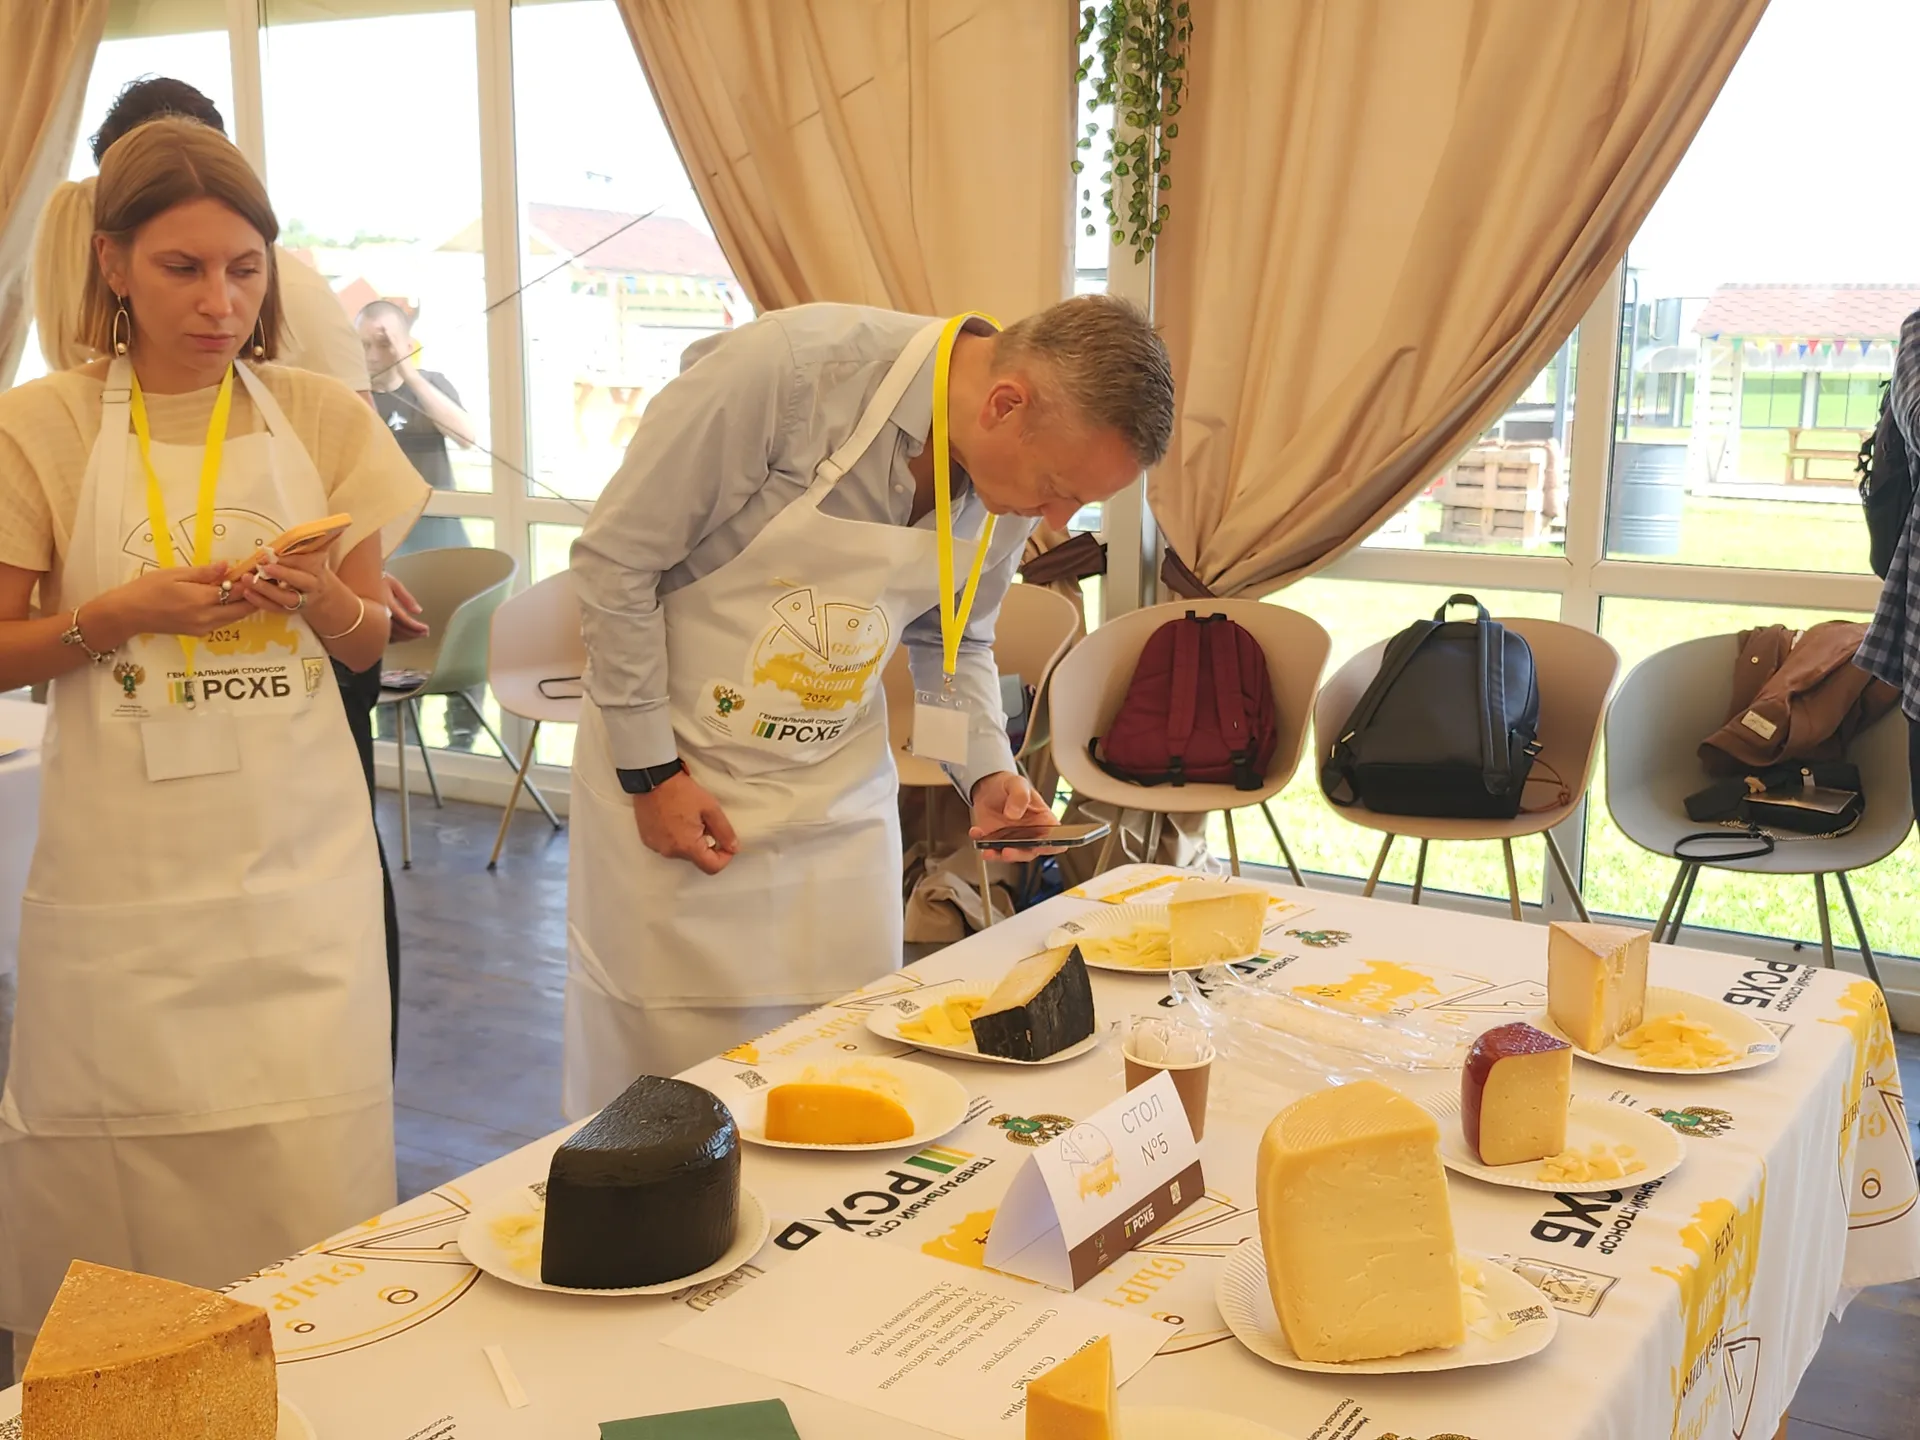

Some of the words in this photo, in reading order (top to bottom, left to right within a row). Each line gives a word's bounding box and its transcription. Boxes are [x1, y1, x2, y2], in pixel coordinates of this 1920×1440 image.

[208, 630, 240, 642] 2024
[167, 668, 239, 679] ГЕНАЛЬНЫЙ
[241, 665, 287, 675] СПОНСОР
[203, 676, 291, 701] РСХБ
[804, 692, 832, 703] 2024
[759, 712, 815, 725] ГЕНЕРАЛЬНЫЙ
[777, 724, 844, 743] РСХБ
[1722, 958, 1798, 1009] РСХБ
[1121, 1093, 1164, 1134] СТОЛ
[898, 1157, 996, 1220] ГЕНЕРАЛЬНЫЙ
[1132, 1207, 1156, 1233] РСХБ
[936, 1324, 970, 1345] Елена
[1023, 1308, 1059, 1337] Список
[846, 1329, 885, 1356] Антуан
[871, 1322, 921, 1357] Виктория
[895, 1327, 939, 1359] Евгений
[934, 1330, 984, 1368] Анастасия
[977, 1334, 1026, 1373] экспертов:
[877, 1344, 940, 1391] Анатольевна
